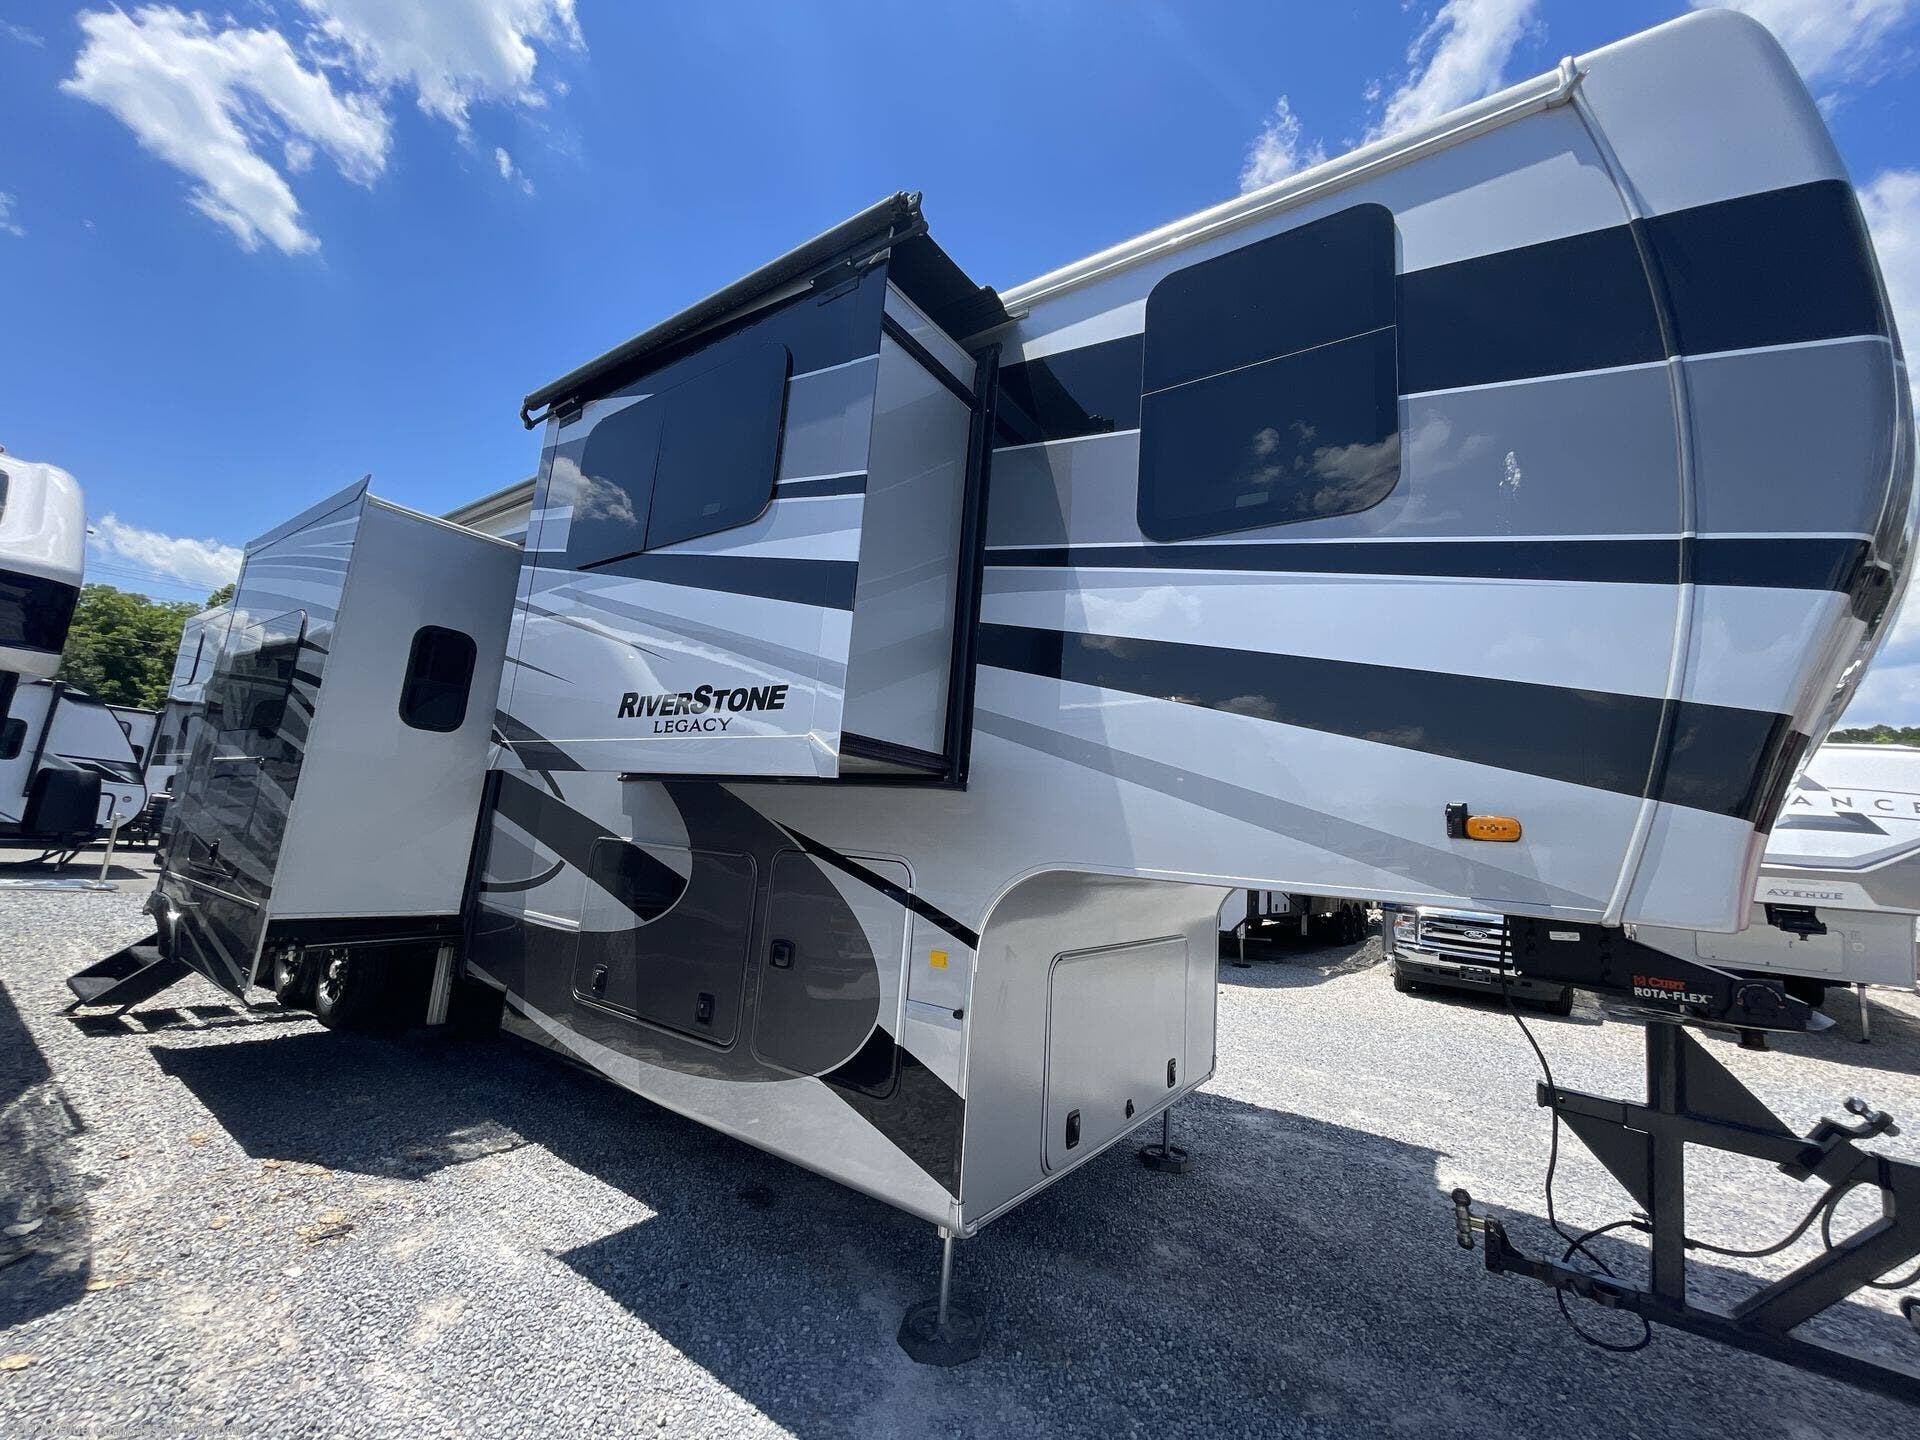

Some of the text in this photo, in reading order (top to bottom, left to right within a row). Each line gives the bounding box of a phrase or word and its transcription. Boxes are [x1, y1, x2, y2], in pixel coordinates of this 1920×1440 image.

[653, 717, 733, 734] LEGACY
[1766, 888, 1844, 901] AVENUE
[1633, 986, 1709, 1005] ROTA-FLEX
